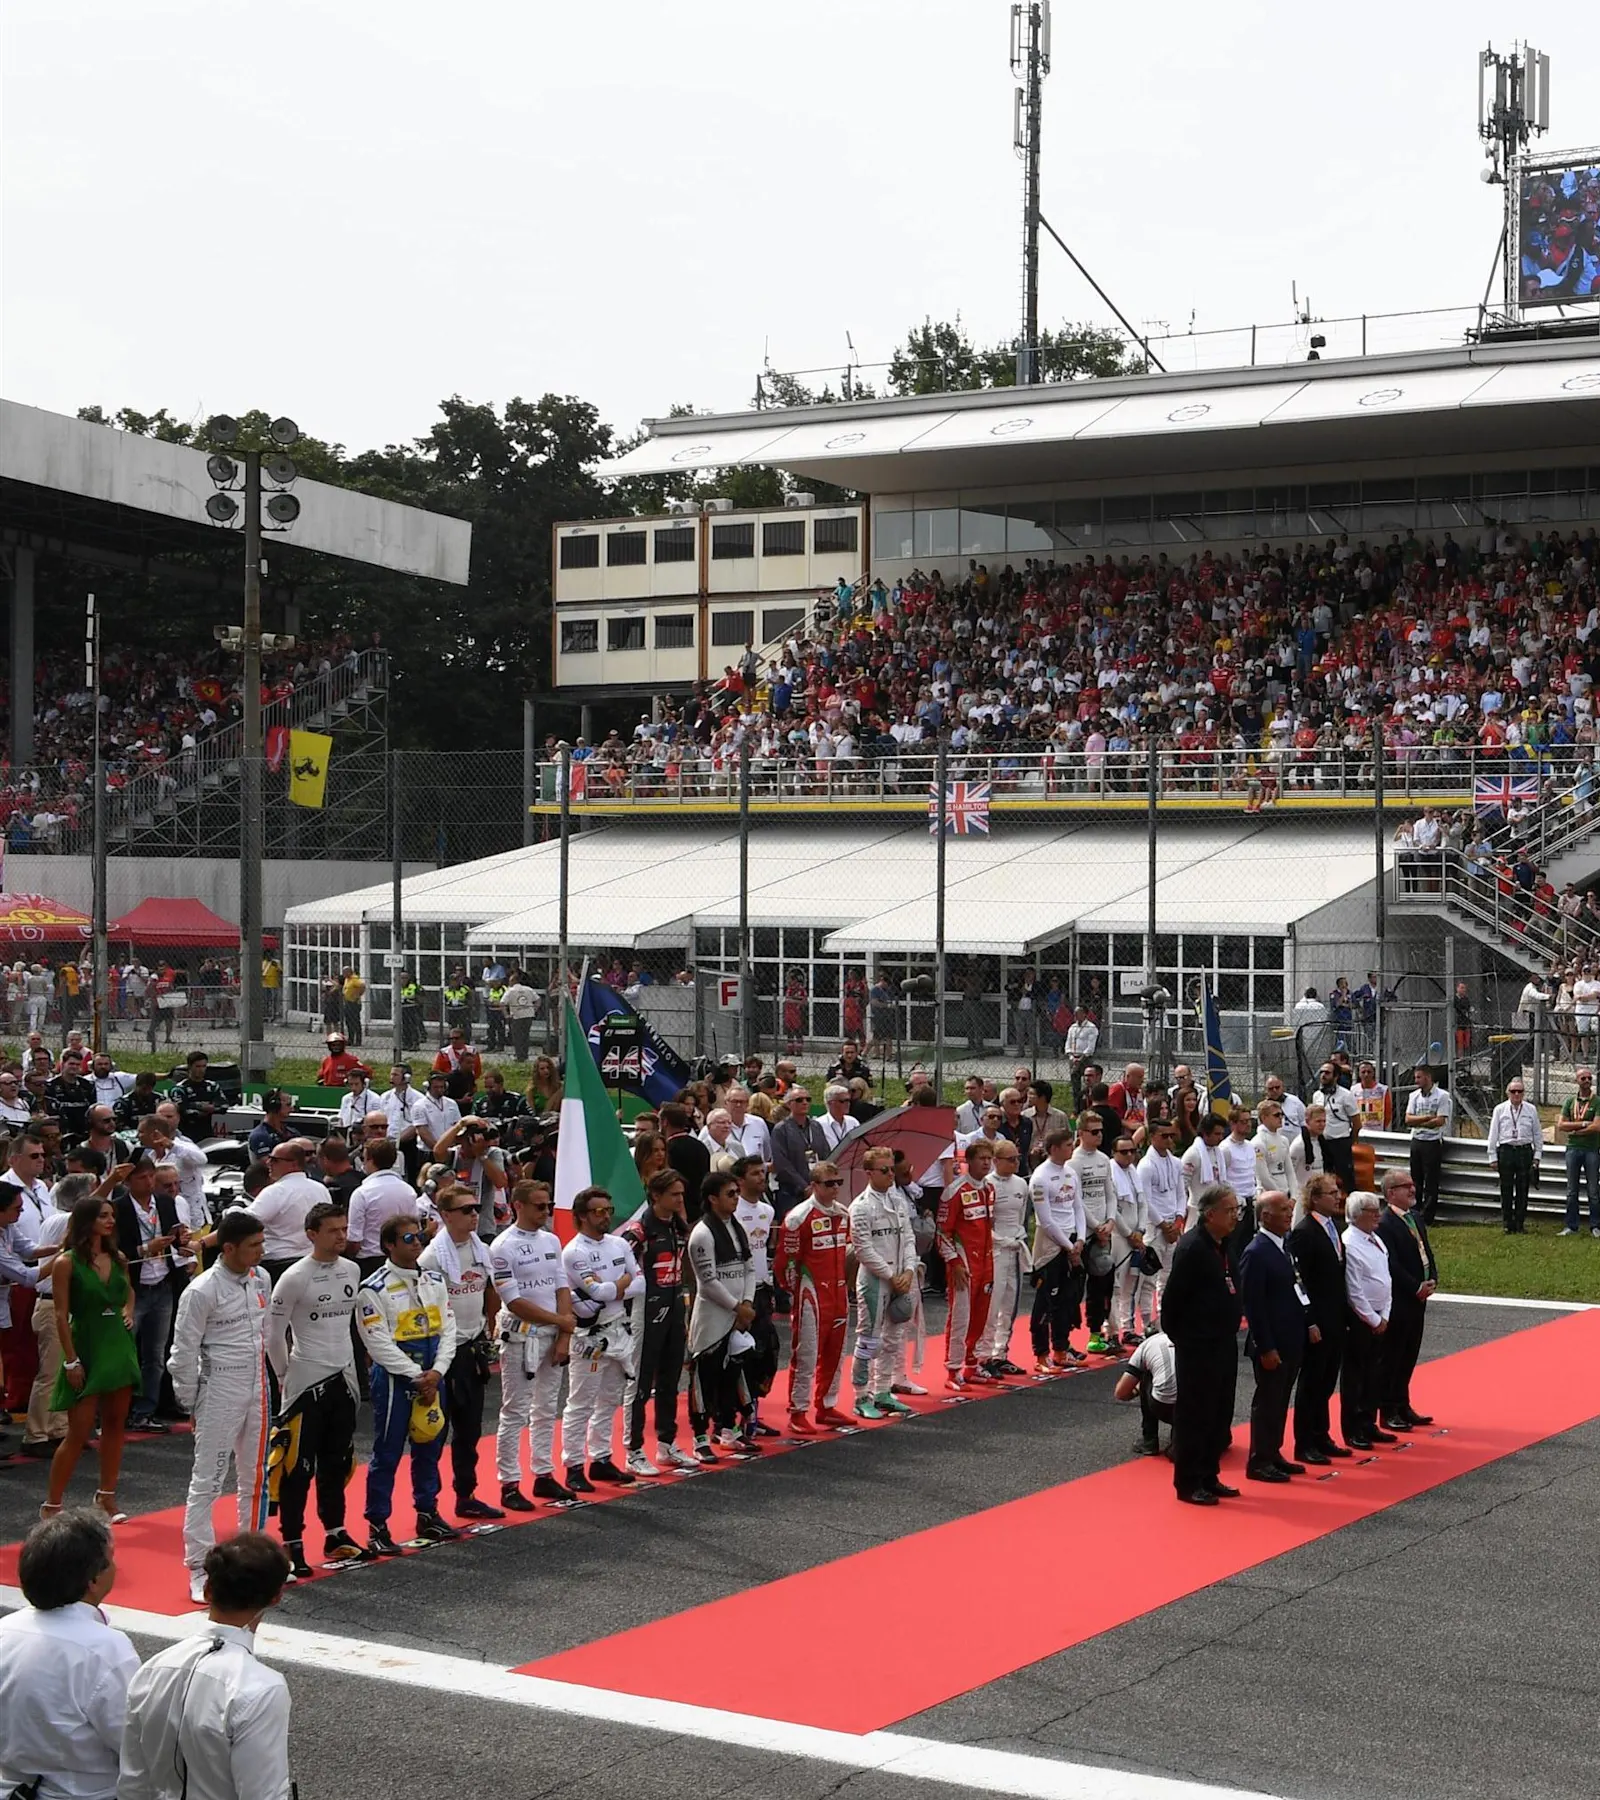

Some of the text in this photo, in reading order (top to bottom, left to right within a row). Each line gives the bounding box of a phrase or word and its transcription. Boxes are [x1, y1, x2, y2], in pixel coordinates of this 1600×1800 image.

[952, 802, 987, 811] HAMILTON
[721, 981, 739, 1006] F
[601, 1045, 640, 1079] 44
